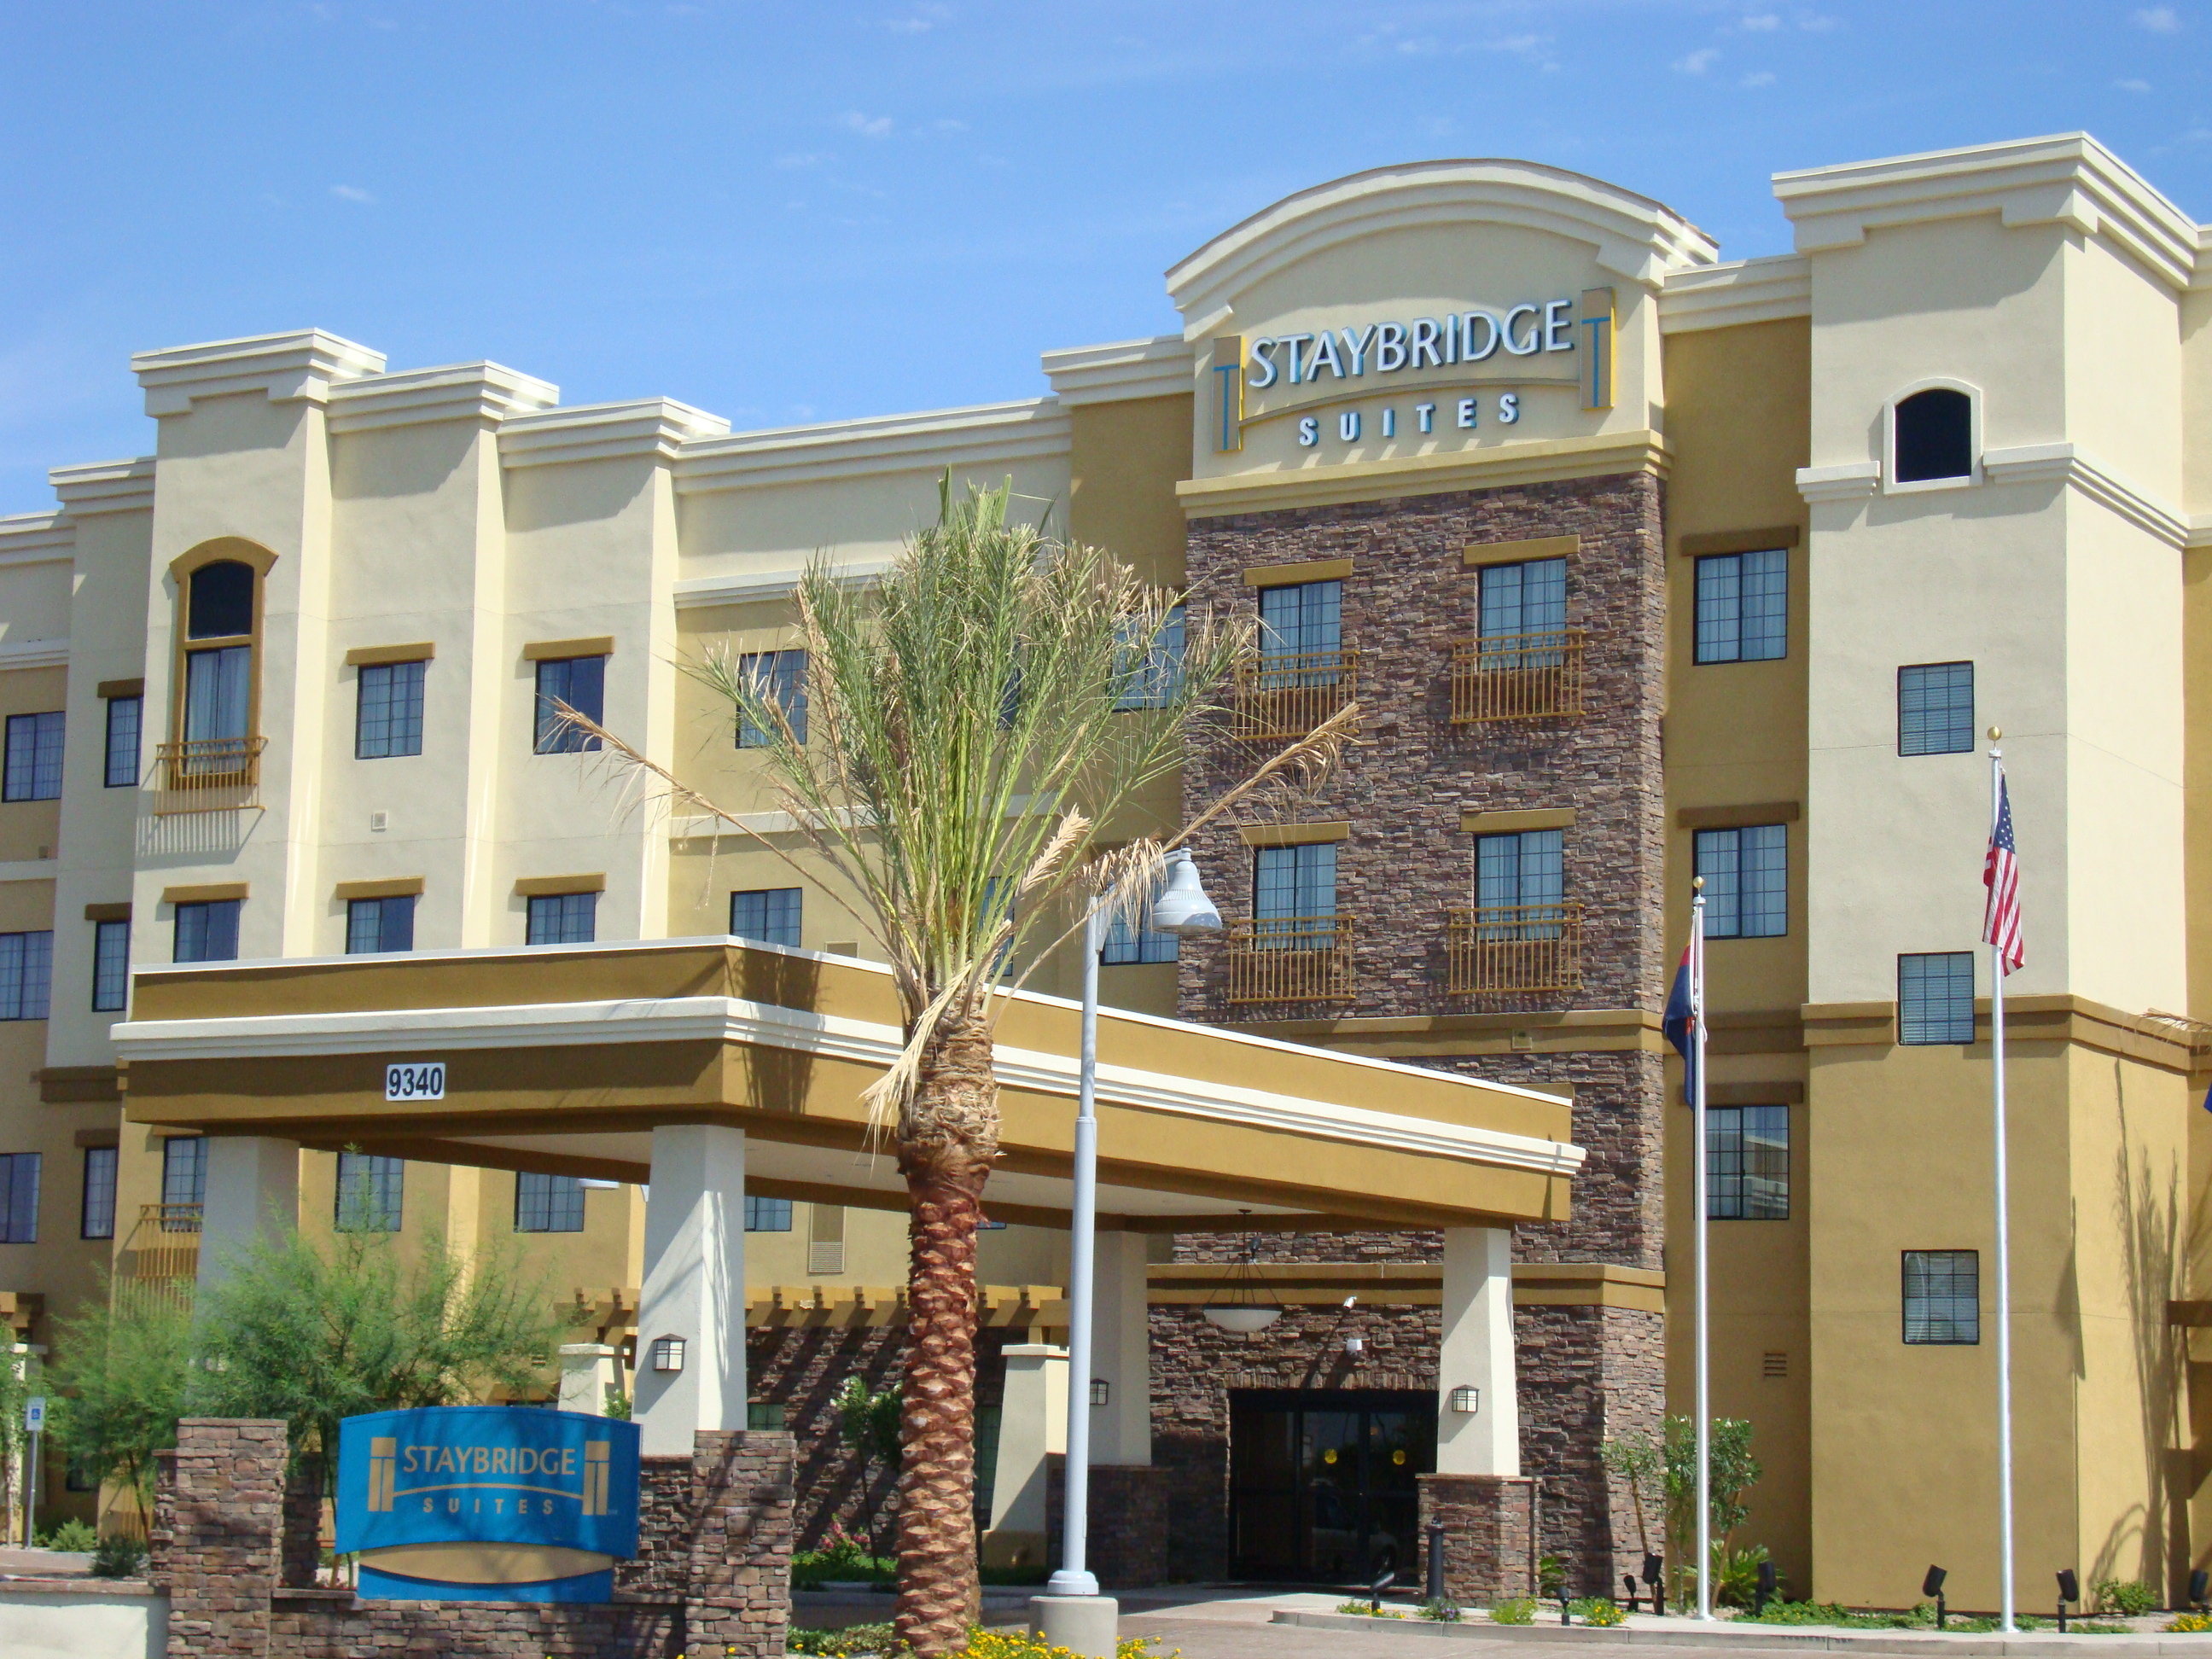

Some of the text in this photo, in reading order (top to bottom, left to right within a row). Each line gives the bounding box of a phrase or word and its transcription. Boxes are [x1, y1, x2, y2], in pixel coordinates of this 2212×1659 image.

[1249, 299, 1575, 389] STAYBRIDGE
[1299, 393, 1519, 447] SUITES
[388, 1067, 443, 1097] 9340
[404, 1446, 576, 1476] STAYBRIDGE
[422, 1498, 554, 1515] SUITES
